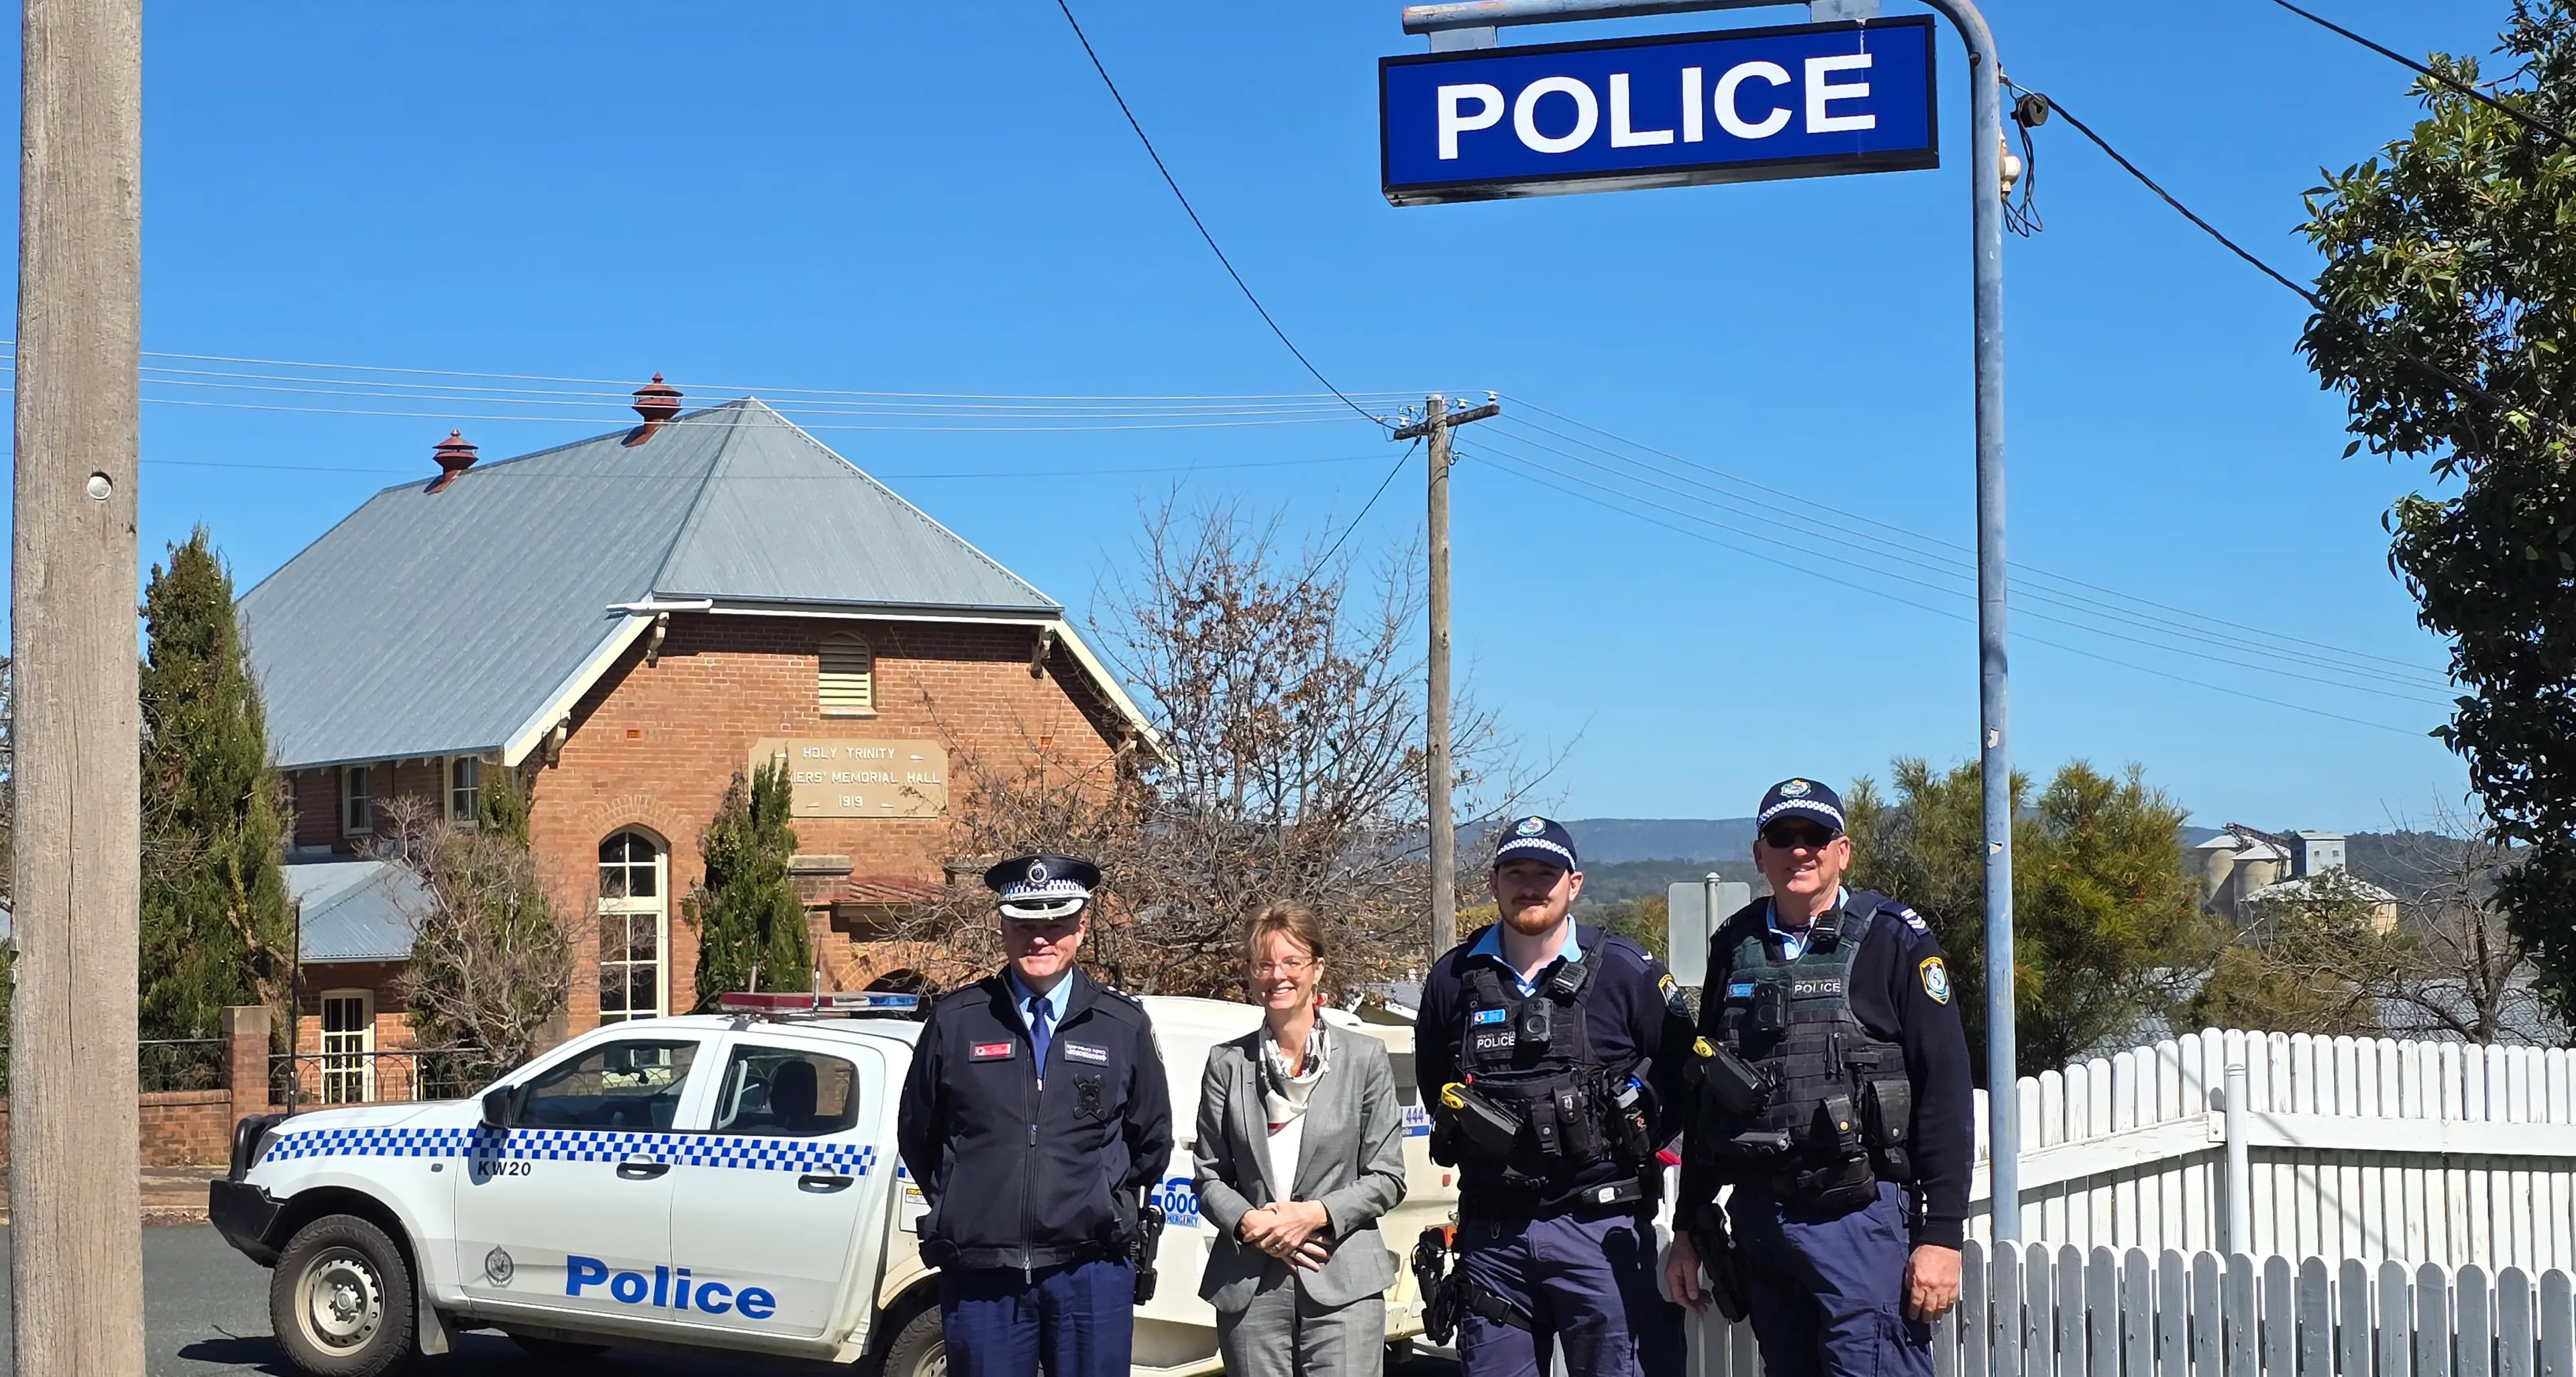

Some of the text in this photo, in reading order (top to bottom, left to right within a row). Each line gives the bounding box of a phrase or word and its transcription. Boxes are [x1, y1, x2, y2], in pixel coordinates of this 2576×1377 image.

[1438, 54, 1876, 160] POLICE
[803, 747, 895, 759] HOLY TRINITY
[831, 772, 898, 783] MEMORIAL
[906, 771, 941, 783] HALL
[839, 795, 863, 808] 1919
[1794, 981, 1841, 994] POLICE
[1477, 1036, 1515, 1049] POLICE
[1406, 1107, 1424, 1124] 444
[477, 1161, 531, 1176] KW20
[1165, 1192, 1199, 1215] 000
[1167, 1215, 1199, 1227] MERGENCY
[566, 1254, 775, 1319] Police
